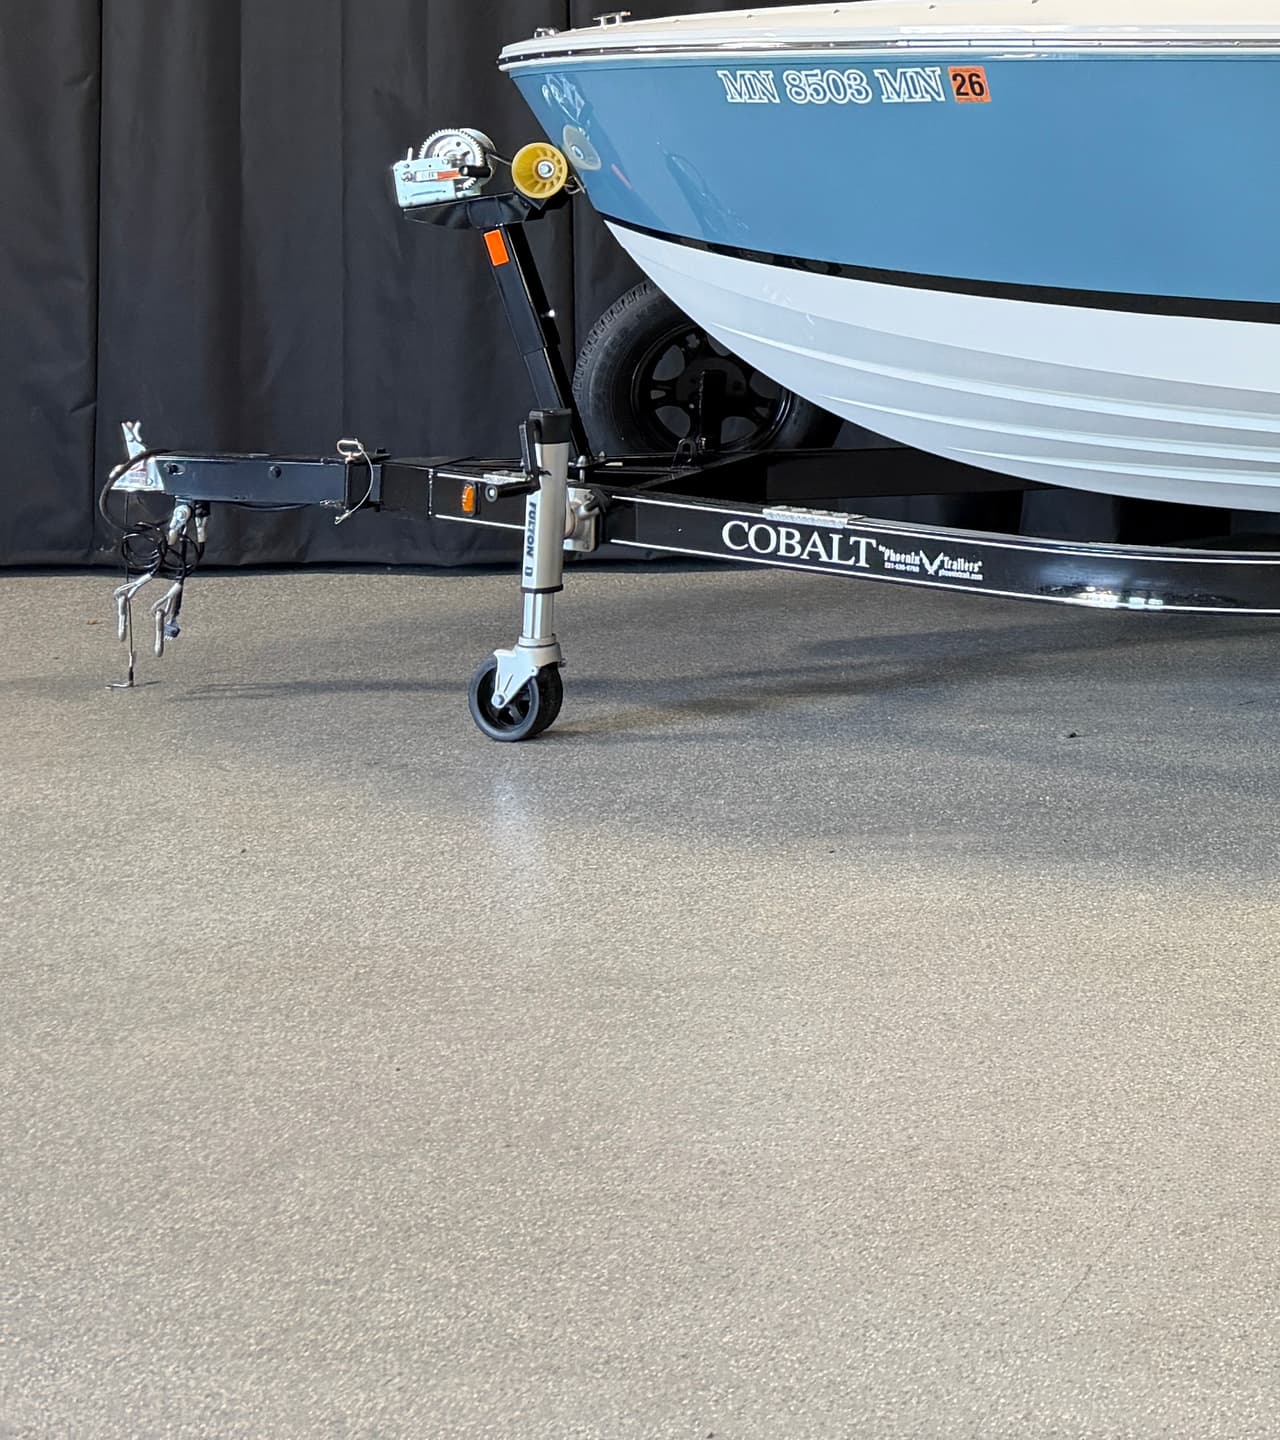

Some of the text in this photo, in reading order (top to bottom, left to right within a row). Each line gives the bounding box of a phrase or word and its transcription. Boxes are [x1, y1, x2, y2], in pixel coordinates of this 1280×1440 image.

[716, 66, 946, 105] MN 8503 MN
[952, 72, 985, 97] 26
[526, 502, 537, 559] FULTON
[721, 520, 877, 569] COBALT
[884, 548, 921, 565] Phoenix
